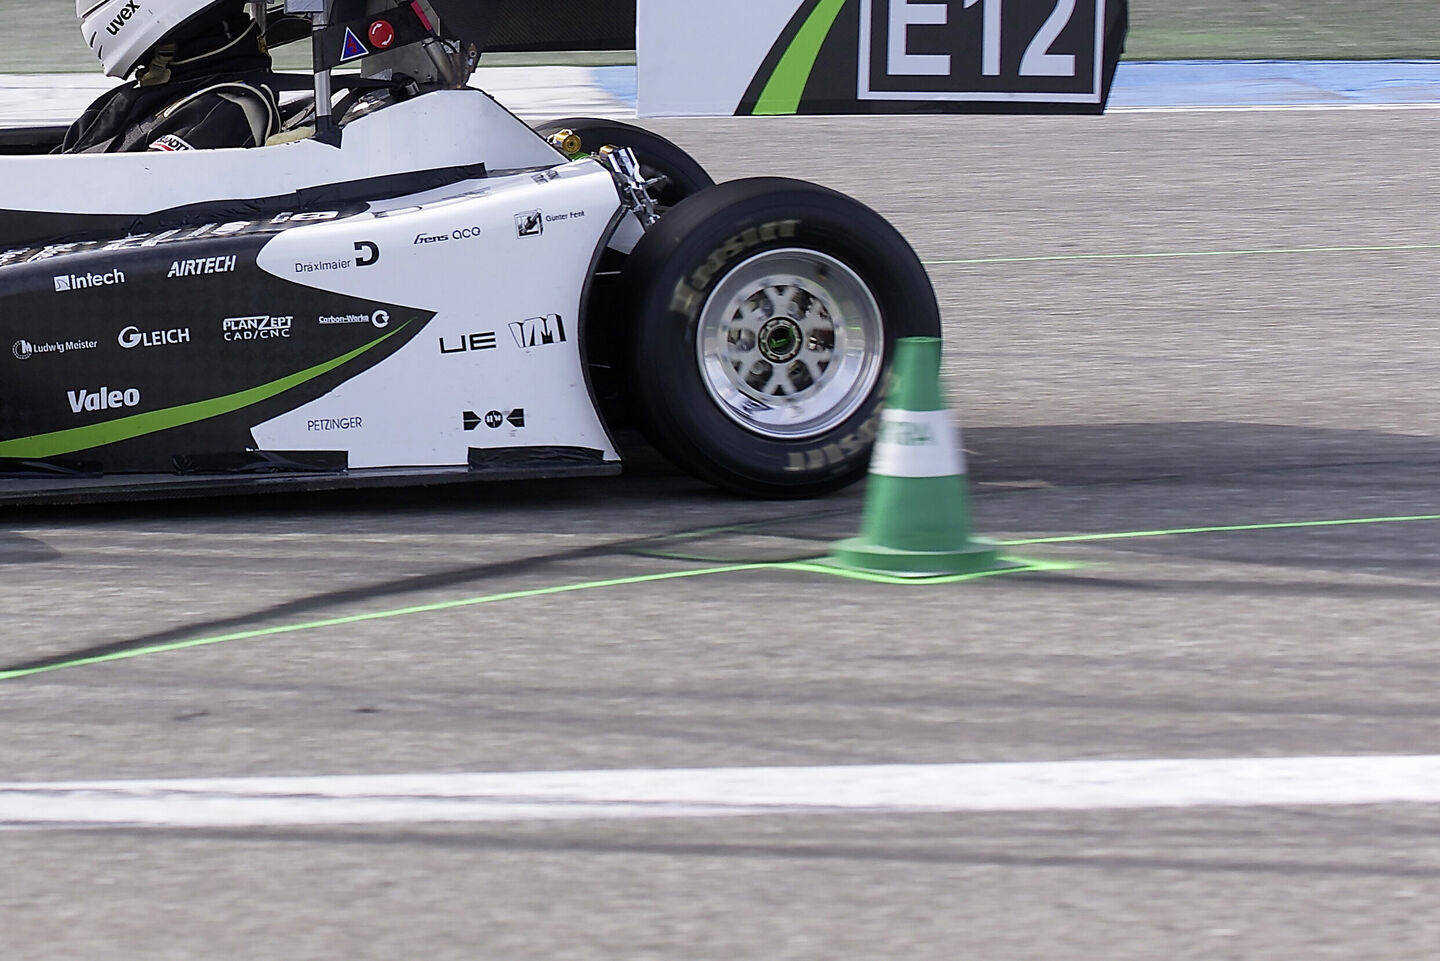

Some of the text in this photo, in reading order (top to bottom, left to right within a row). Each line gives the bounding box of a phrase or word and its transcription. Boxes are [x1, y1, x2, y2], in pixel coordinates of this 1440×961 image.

[106, 0, 140, 35] uvex
[167, 255, 236, 277] AIRTECH
[223, 315, 293, 331] PLANZEPT
[118, 325, 190, 349] GLEICH
[223, 329, 290, 341] CAD/CNC
[33, 339, 98, 353] Ludwig Meister
[67, 386, 140, 413] Valeo
[307, 416, 362, 431] PETZINGER
